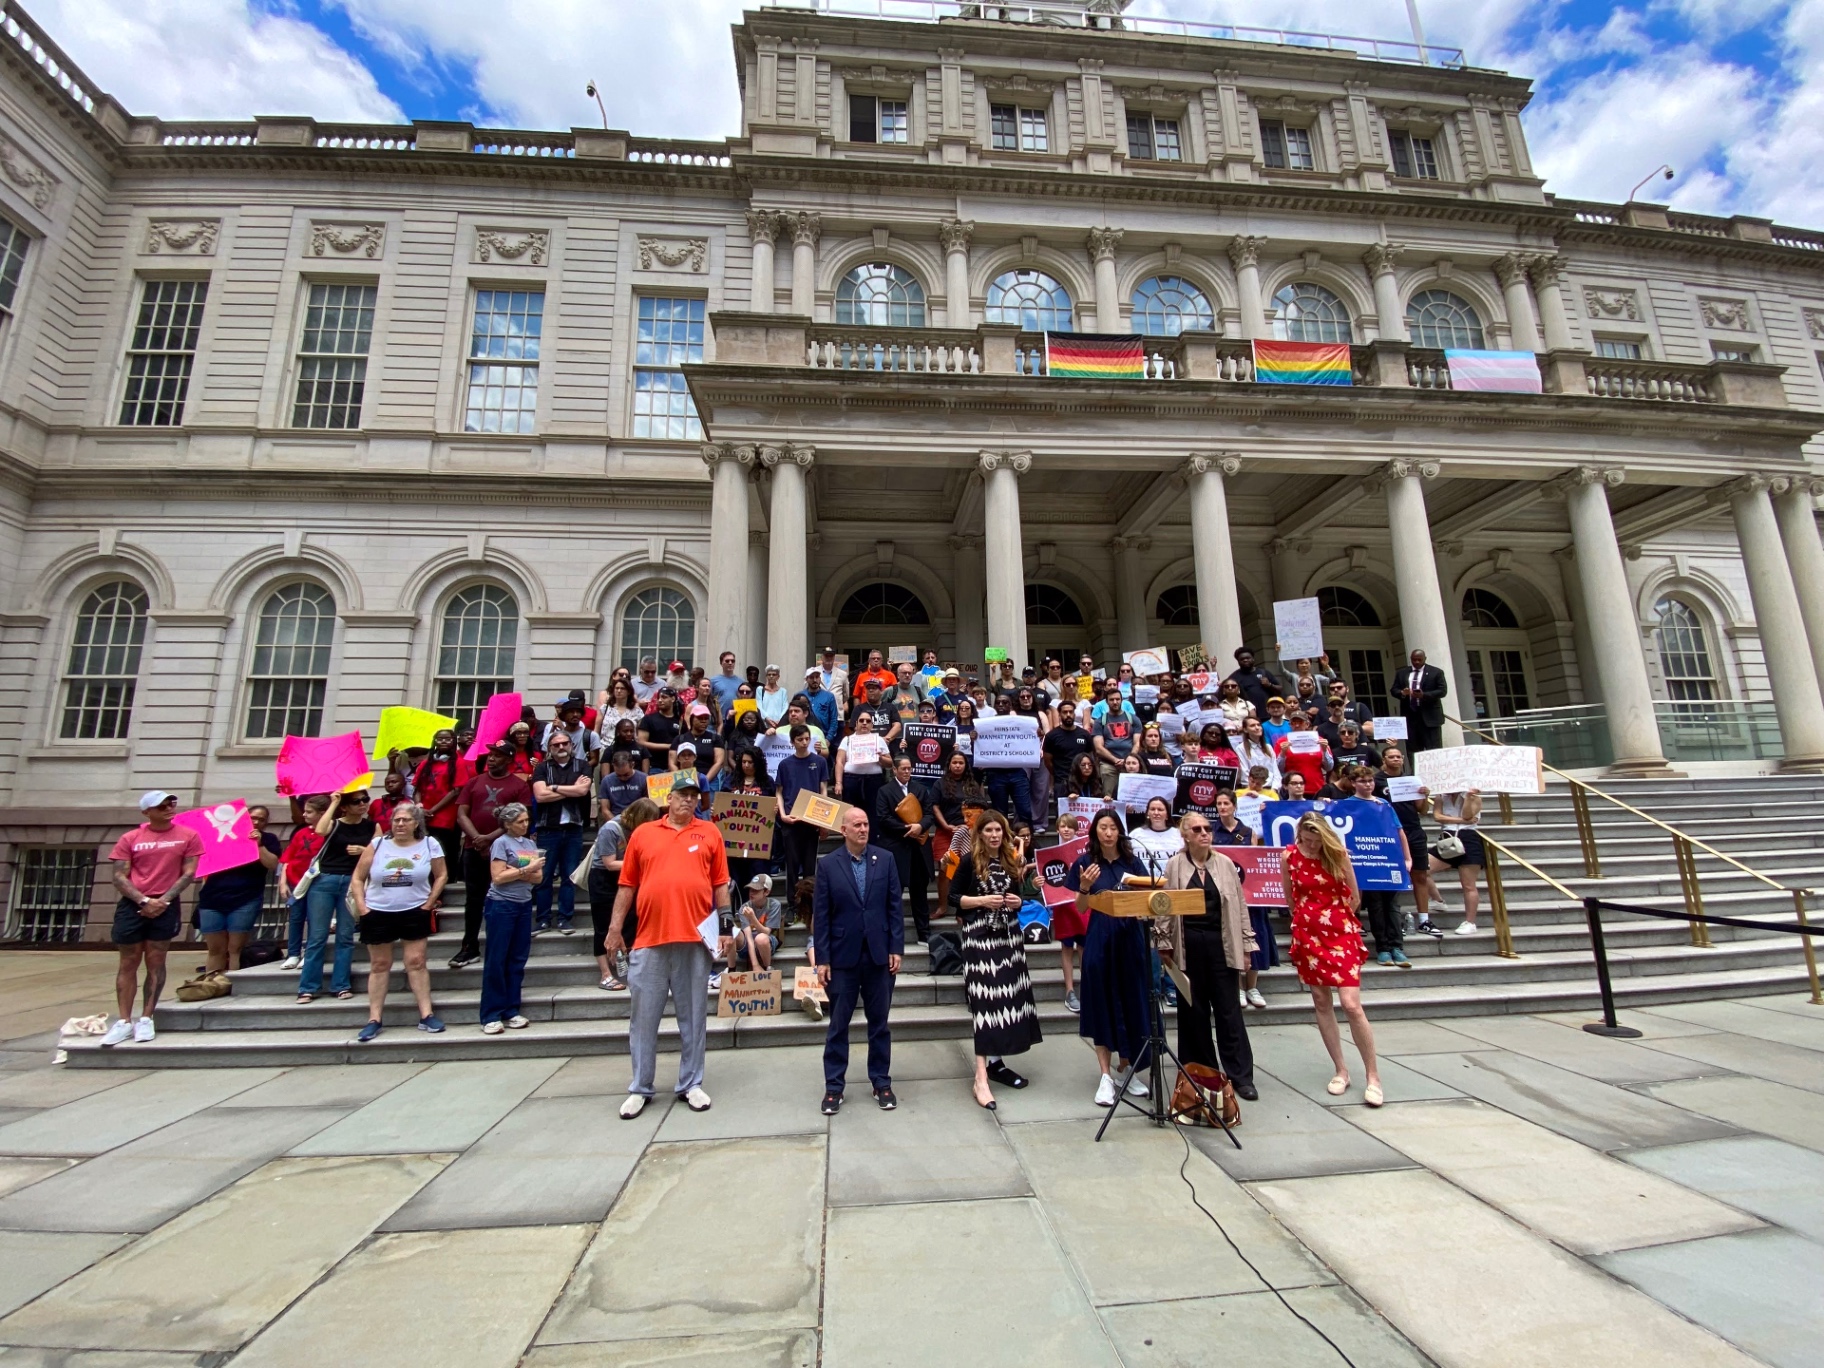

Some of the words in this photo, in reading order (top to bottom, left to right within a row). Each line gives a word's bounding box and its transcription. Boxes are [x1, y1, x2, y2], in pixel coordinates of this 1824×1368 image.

[1180, 644, 1202, 657] SAVE
[1185, 652, 1200, 660] OUR
[965, 664, 978, 672] OUR
[1459, 748, 1485, 758] TAKE
[1419, 757, 1487, 772] MANHATTAN
[731, 800, 758, 809] SAVE
[711, 810, 774, 829] MANHATTAN
[724, 822, 760, 833] YOUTH
[1355, 836, 1396, 844] MANHATTAN
[729, 975, 747, 984] WE
[753, 972, 772, 982] LOVE
[728, 996, 774, 1013] YOUTH!
